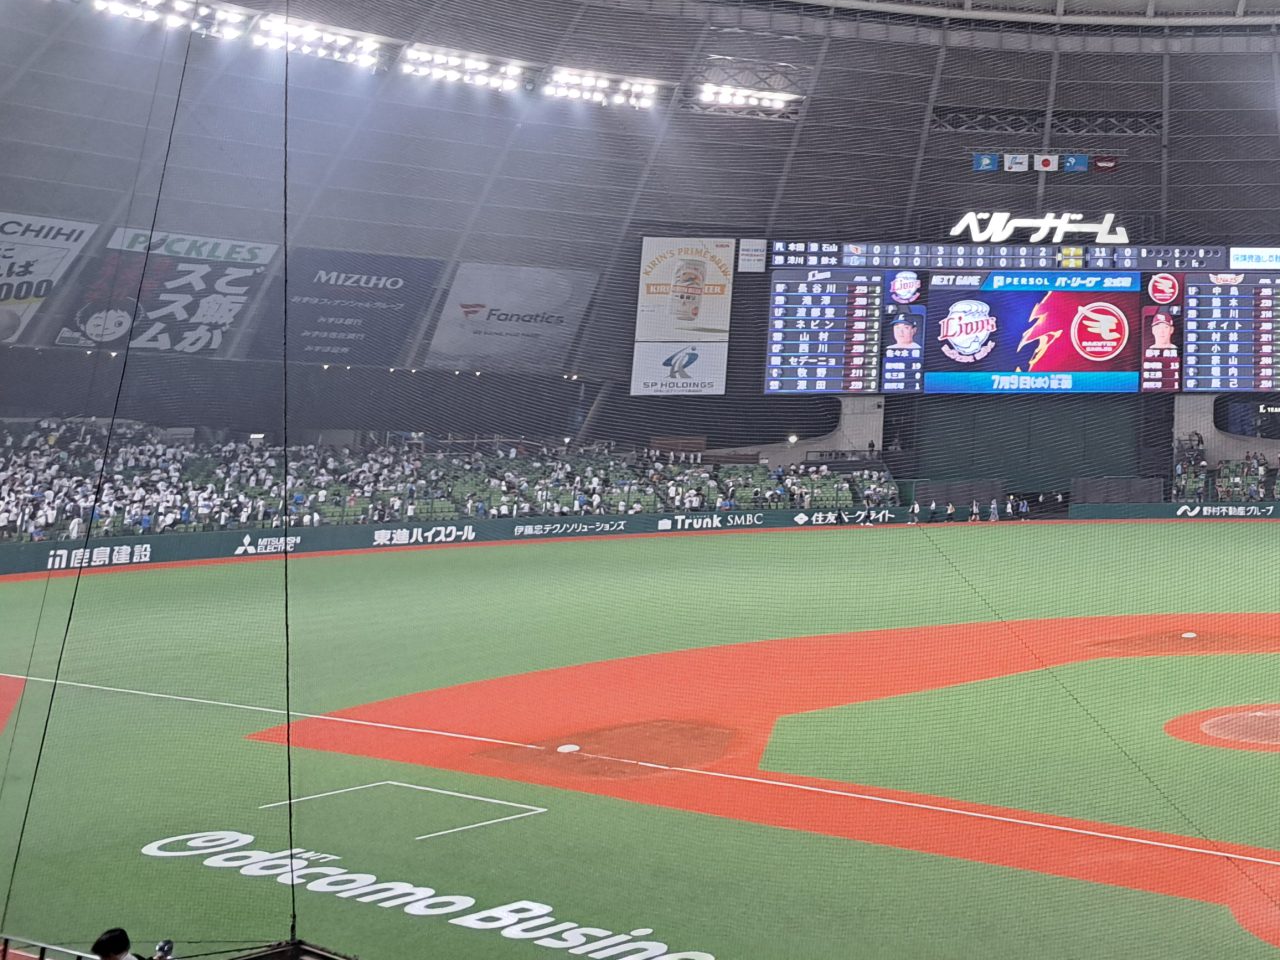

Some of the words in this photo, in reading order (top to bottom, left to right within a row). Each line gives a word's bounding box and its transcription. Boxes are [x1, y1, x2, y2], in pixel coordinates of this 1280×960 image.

[949, 211, 1130, 243] ベルーナドーム
[677, 247, 710, 258] PRIME
[313, 270, 404, 289] MIZUHO
[931, 275, 955, 285] NEXT
[955, 275, 981, 285] GAME
[1006, 277, 1050, 286] PERSOL
[485, 308, 565, 324] Fanatics
[796, 320, 834, 329] ネビン
[937, 316, 997, 341] Lions
[789, 356, 836, 365] セデーニョ
[643, 381, 657, 389] SP
[660, 381, 715, 389] HOLDINGS
[1202, 506, 1274, 517] 野村不動産グループ
[677, 514, 722, 529] Trunk
[727, 514, 764, 526] SMBC
[373, 525, 476, 546] 東進ハイスクール
[257, 544, 294, 553] ELECTRIC
[70, 544, 151, 568] 鹿島建設
[203, 847, 477, 916] docomo
